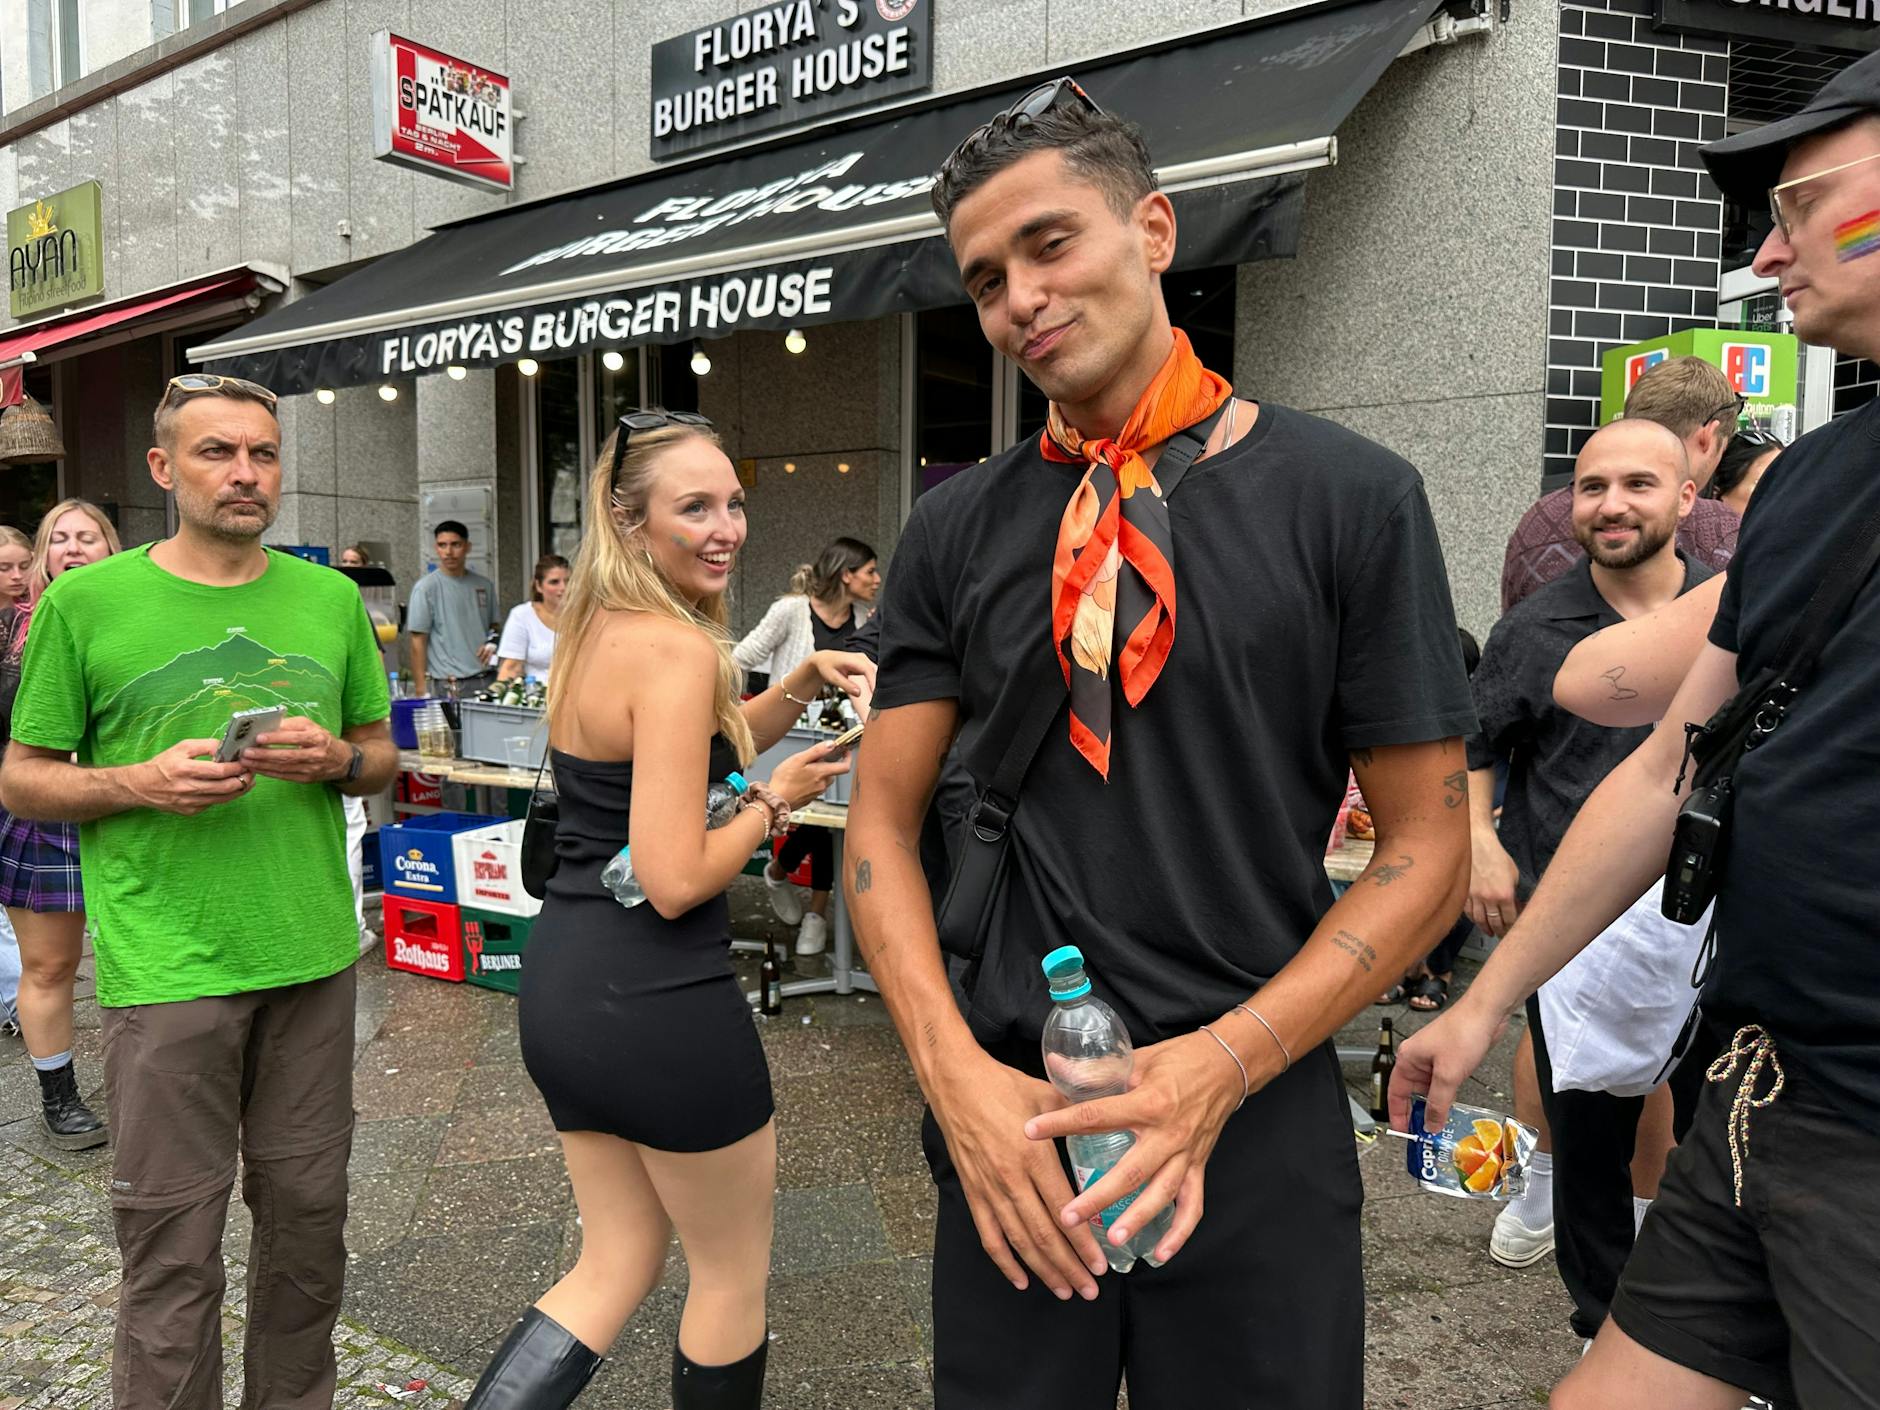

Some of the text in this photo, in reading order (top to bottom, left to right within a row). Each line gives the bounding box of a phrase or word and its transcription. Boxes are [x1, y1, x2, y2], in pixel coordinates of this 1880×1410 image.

[654, 27, 908, 138] BURGER HOUSE
[400, 76, 505, 139] SPÄTKAUF
[415, 123, 449, 140] BERLIN
[10, 228, 77, 292] AYAN
[382, 266, 834, 374] FLORYA'S BURGER HOUSE
[1752, 312, 1774, 323] Uber
[406, 871, 429, 883] Extra
[394, 938, 450, 972] Rothaus
[480, 954, 522, 971] BERLINER
[1437, 1127, 1455, 1163] ORANGE
